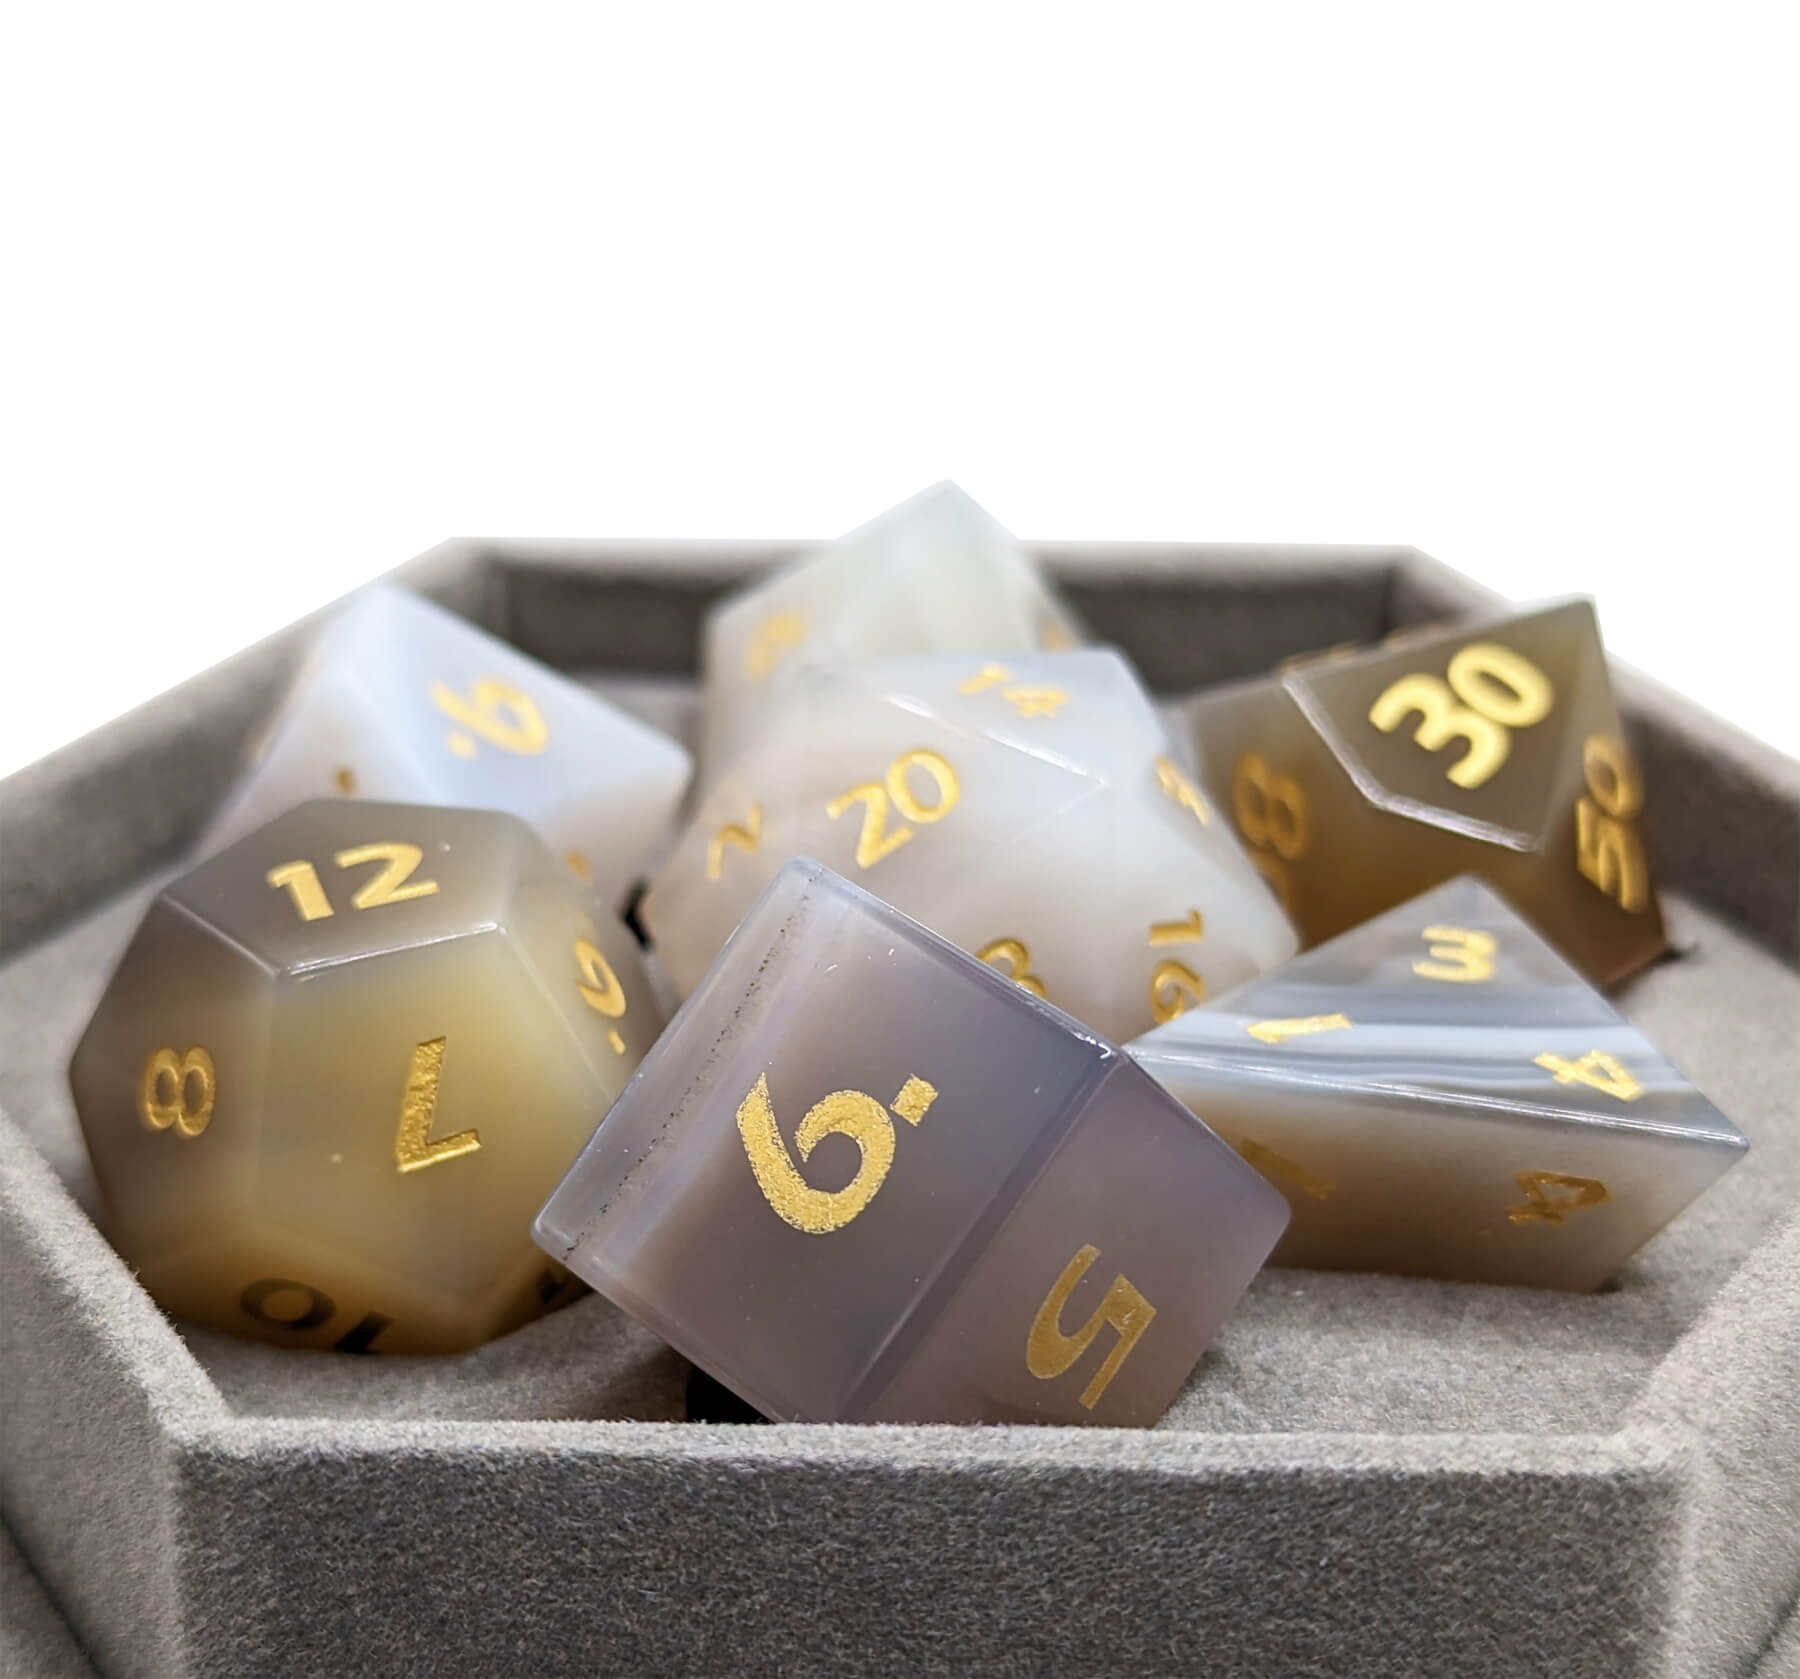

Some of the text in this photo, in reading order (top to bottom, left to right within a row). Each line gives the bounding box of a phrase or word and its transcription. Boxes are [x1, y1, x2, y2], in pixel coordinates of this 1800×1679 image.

[1369, 643, 1555, 789] 30
[826, 749, 960, 869] 20
[1574, 735, 1648, 912] 50
[267, 842, 439, 920] 12
[1412, 926, 1497, 982] 3
[143, 1046, 215, 1136] 8
[395, 1036, 481, 1173] 7
[1532, 1049, 1644, 1101] 4
[1507, 1169, 1613, 1224] 4
[1026, 1242, 1157, 1409] 5
